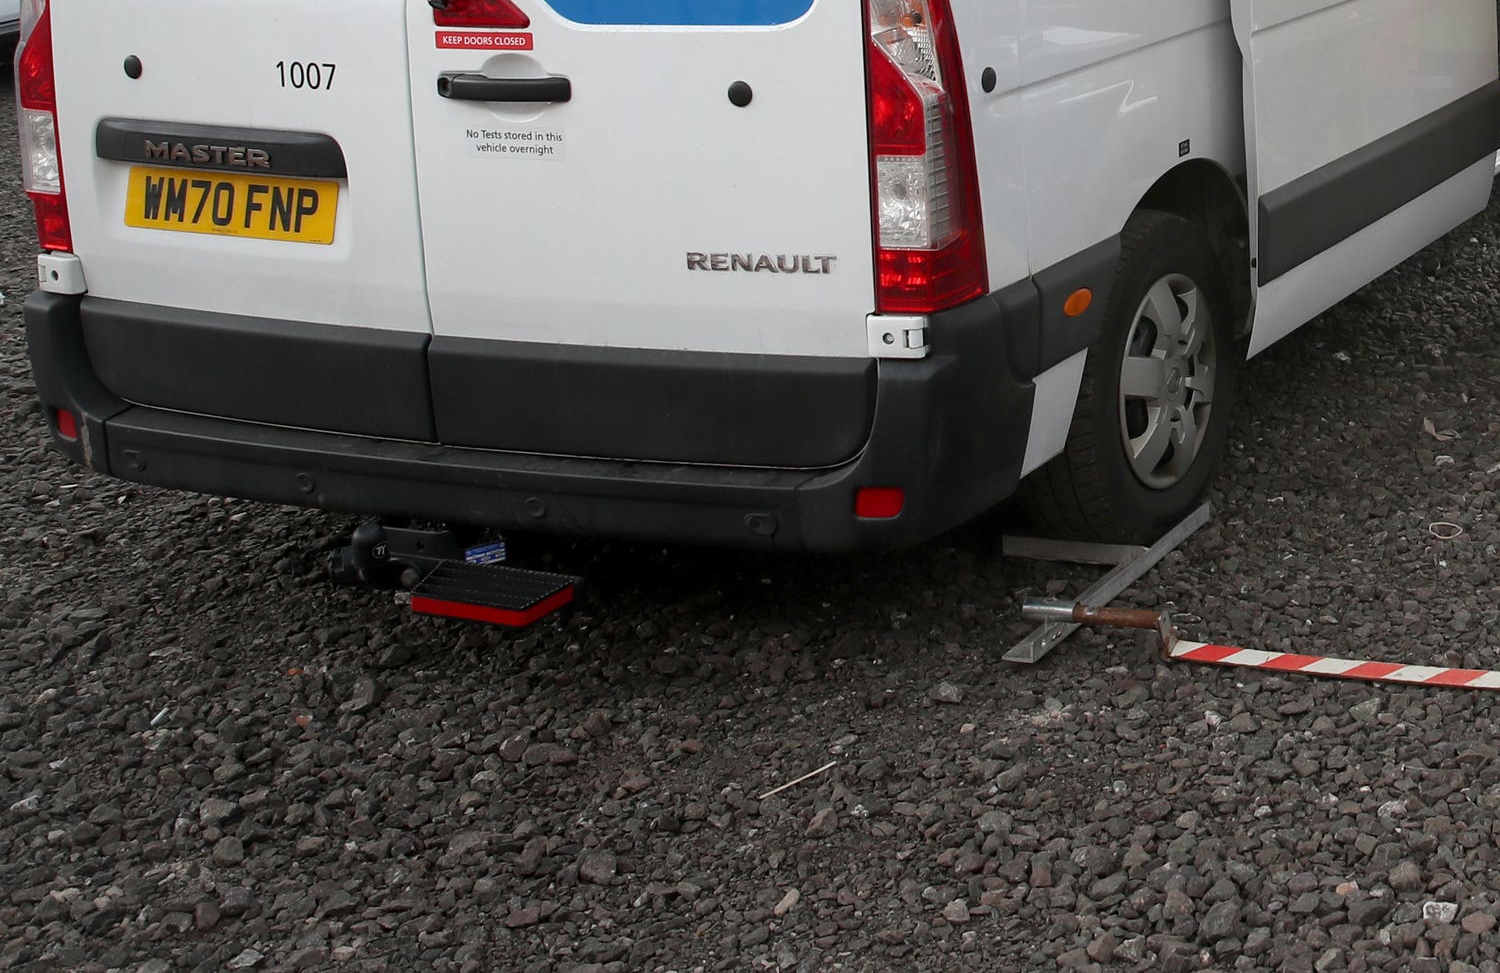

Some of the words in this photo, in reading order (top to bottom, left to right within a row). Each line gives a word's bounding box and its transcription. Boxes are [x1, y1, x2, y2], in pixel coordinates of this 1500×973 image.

[442, 36, 463, 44] KEEP
[464, 37, 493, 45] DOORS
[494, 37, 526, 46] CLOSED
[276, 61, 336, 90] 1007
[466, 129, 479, 138] No
[481, 130, 502, 139] Tests
[504, 131, 532, 140] stored
[535, 131, 543, 141] in
[546, 132, 562, 142] this
[144, 140, 271, 168] MASTER
[476, 143, 507, 153] vehicle
[509, 144, 554, 156] overnight
[144, 176, 235, 226] WM70
[244, 184, 319, 233] FNP
[686, 252, 837, 275] RENAULT
